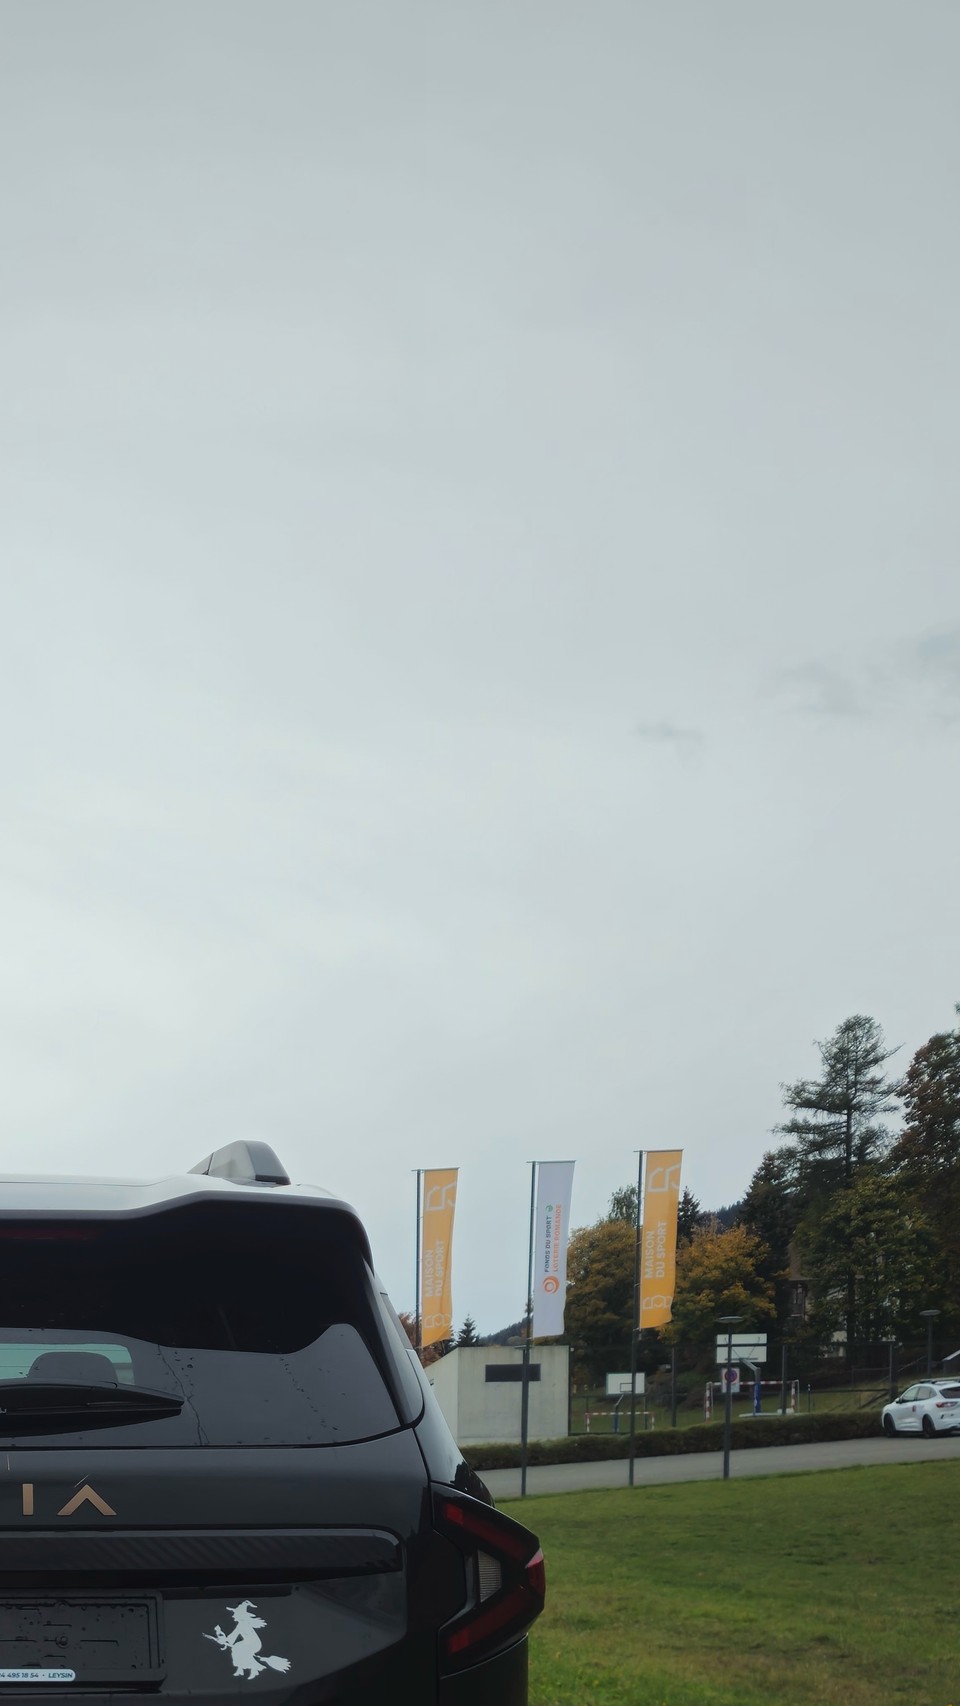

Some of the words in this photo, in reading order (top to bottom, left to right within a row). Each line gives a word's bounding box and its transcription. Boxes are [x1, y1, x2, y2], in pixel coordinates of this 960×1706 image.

[554, 1204, 562, 1240] ROMANDE
[656, 1221, 666, 1259] SPORT
[435, 1240, 444, 1278] SPORT
[545, 1239, 551, 1249] DU
[644, 1231, 654, 1279] MAISON
[424, 1249, 433, 1297] MAISON
[435, 1279, 443, 1297] DU
[656, 1262, 664, 1278] DU
